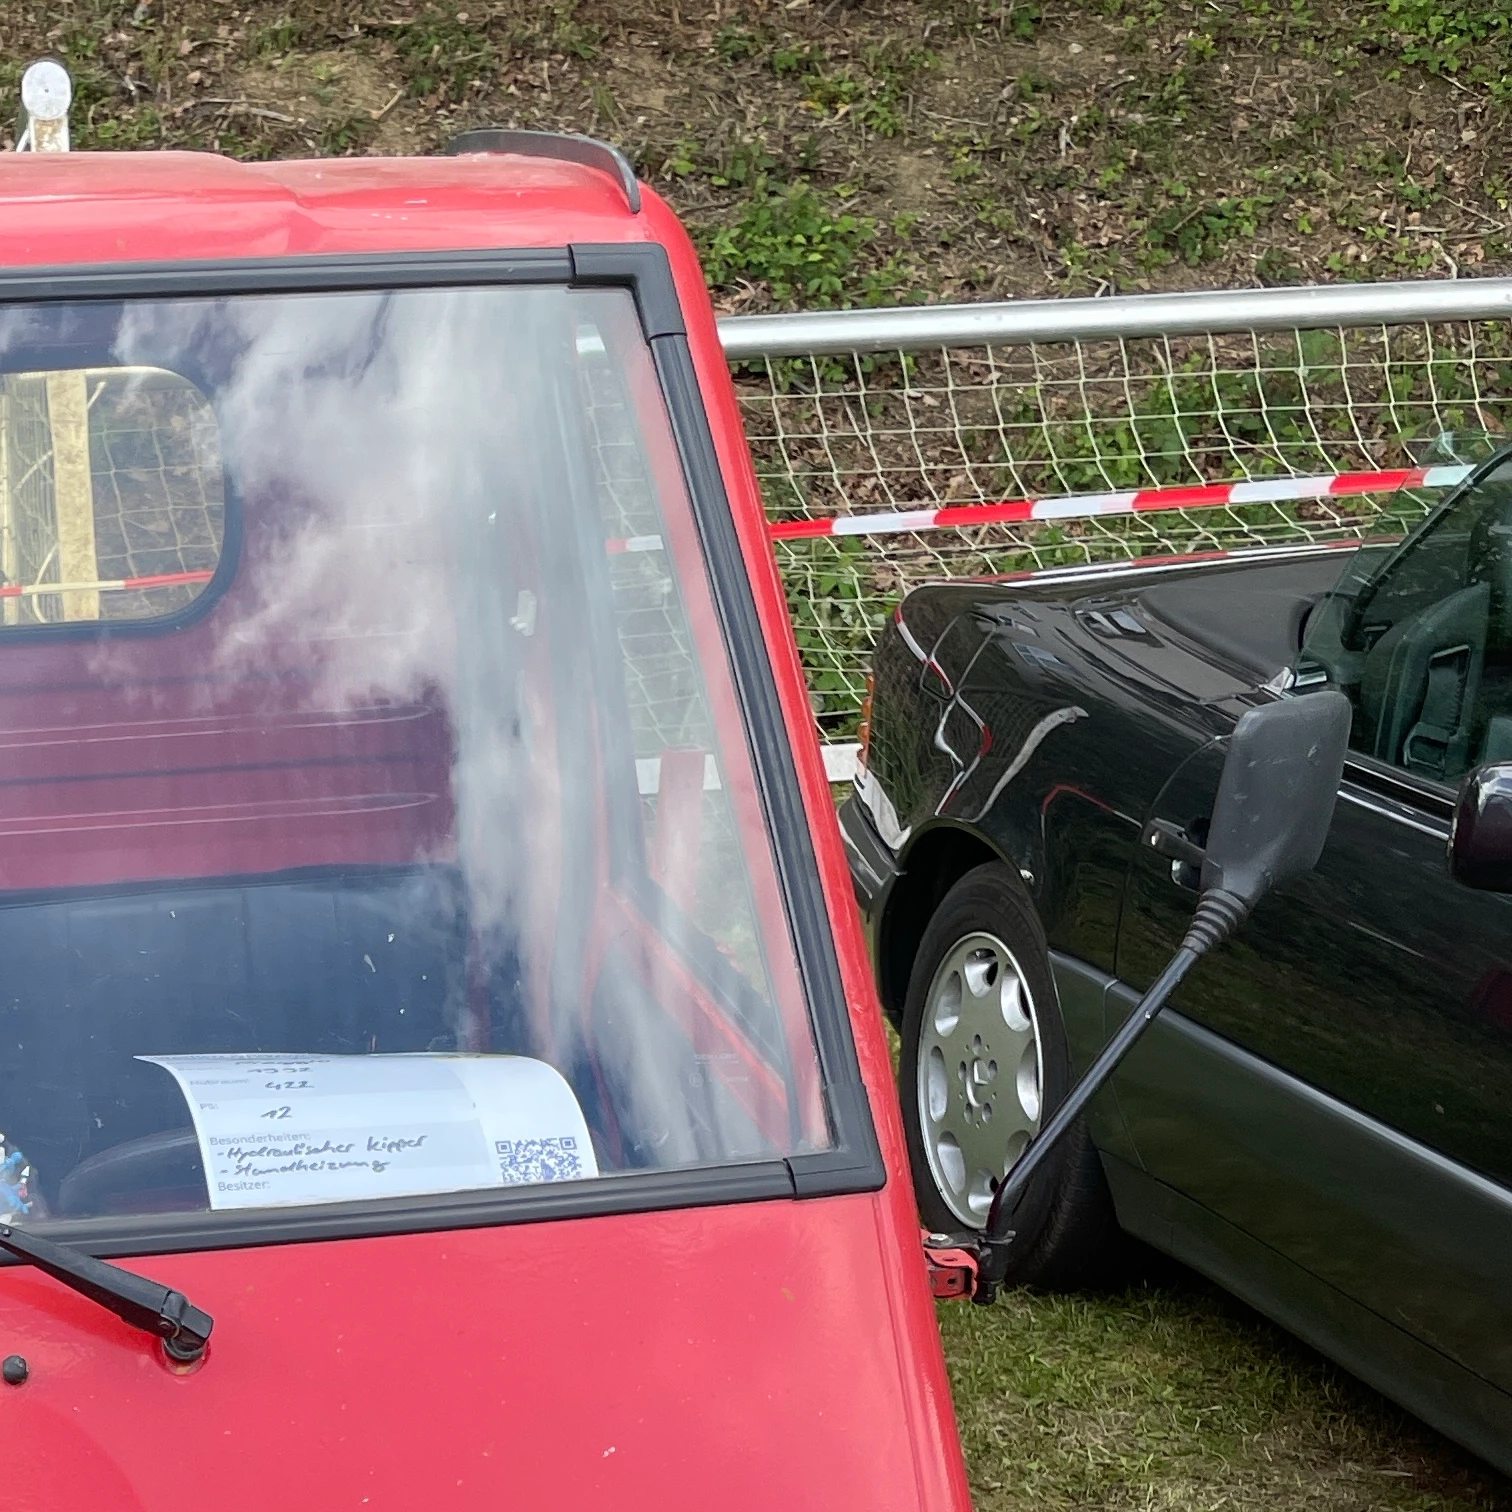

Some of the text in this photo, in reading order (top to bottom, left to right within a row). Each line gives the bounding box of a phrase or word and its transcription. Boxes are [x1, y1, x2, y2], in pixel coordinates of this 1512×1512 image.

[260, 1105, 293, 1120] 12
[208, 1131, 311, 1146] Besonderheiten:
[217, 1179, 271, 1193] Besitzer:
